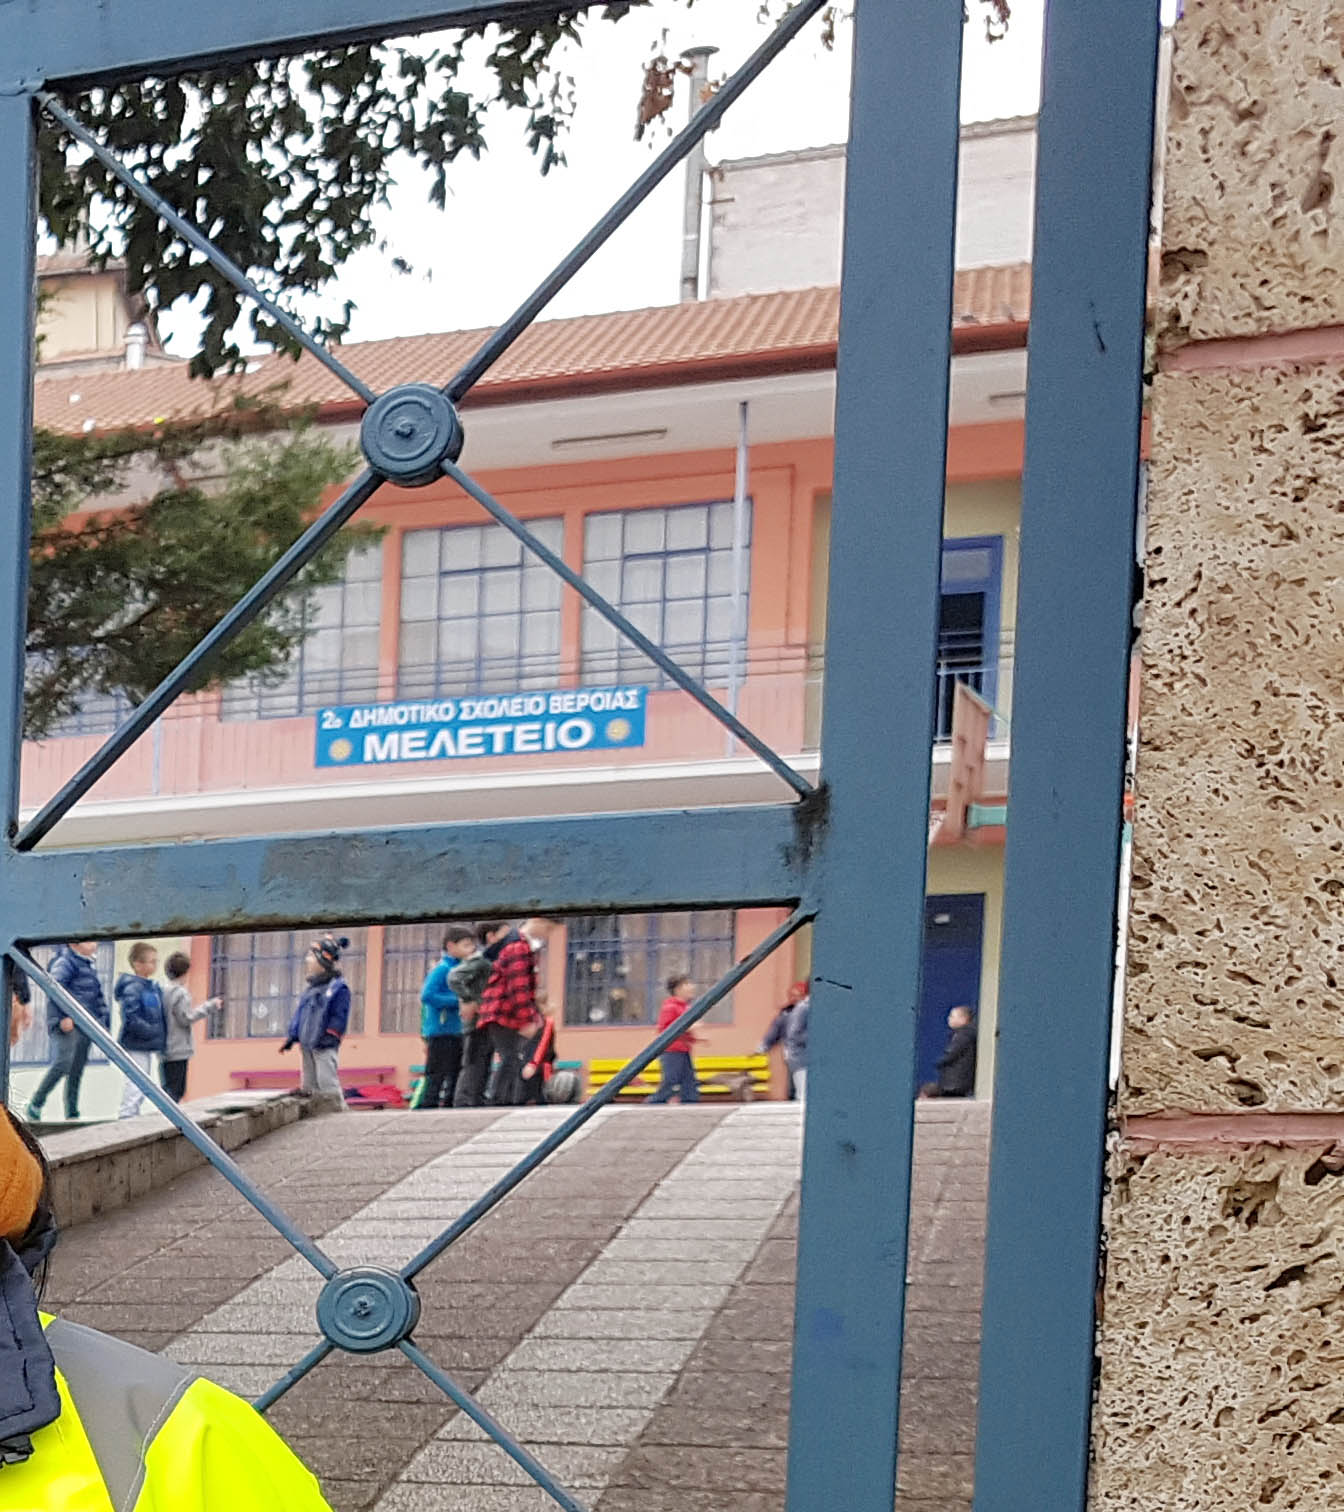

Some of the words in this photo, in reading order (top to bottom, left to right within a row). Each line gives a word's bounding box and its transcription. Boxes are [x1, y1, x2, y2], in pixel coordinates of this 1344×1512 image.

[349, 701, 456, 728] ΔΗΜΟΤΙΚΟ
[458, 695, 544, 721] ΣΧΟΛΕΙΟ
[549, 689, 641, 714] ΒΕΡΟΙΑΣ
[363, 719, 594, 762] ΜΕΛΕΤΕΙΟ
